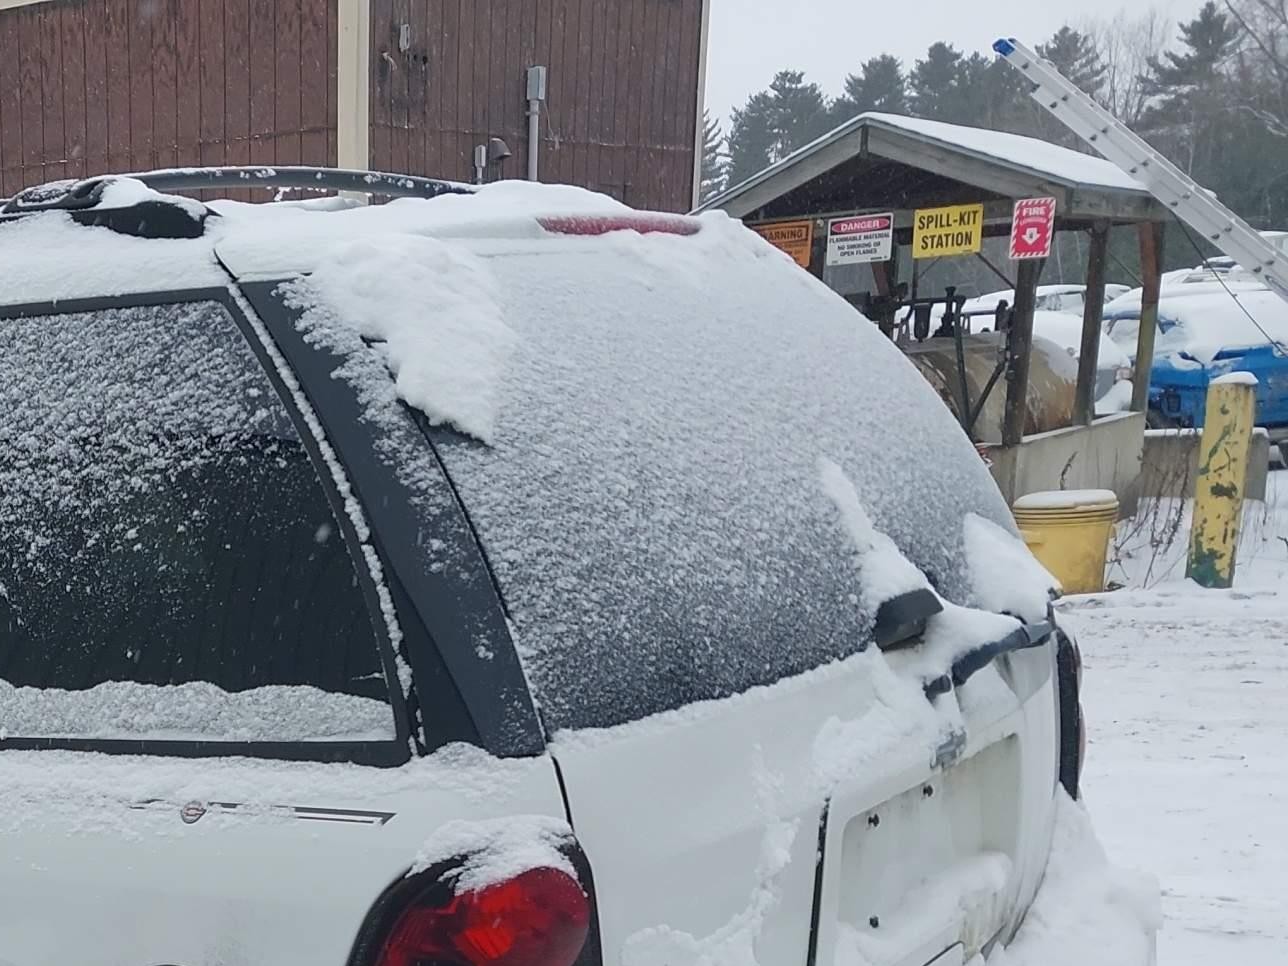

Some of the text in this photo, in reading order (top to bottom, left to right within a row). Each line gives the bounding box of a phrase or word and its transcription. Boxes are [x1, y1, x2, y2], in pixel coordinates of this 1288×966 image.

[1022, 206, 1047, 216] FIRE
[840, 220, 880, 232] DANGER
[918, 210, 979, 230] SPILL-KIT
[764, 228, 804, 240] ARNING
[921, 231, 973, 250] STATION
